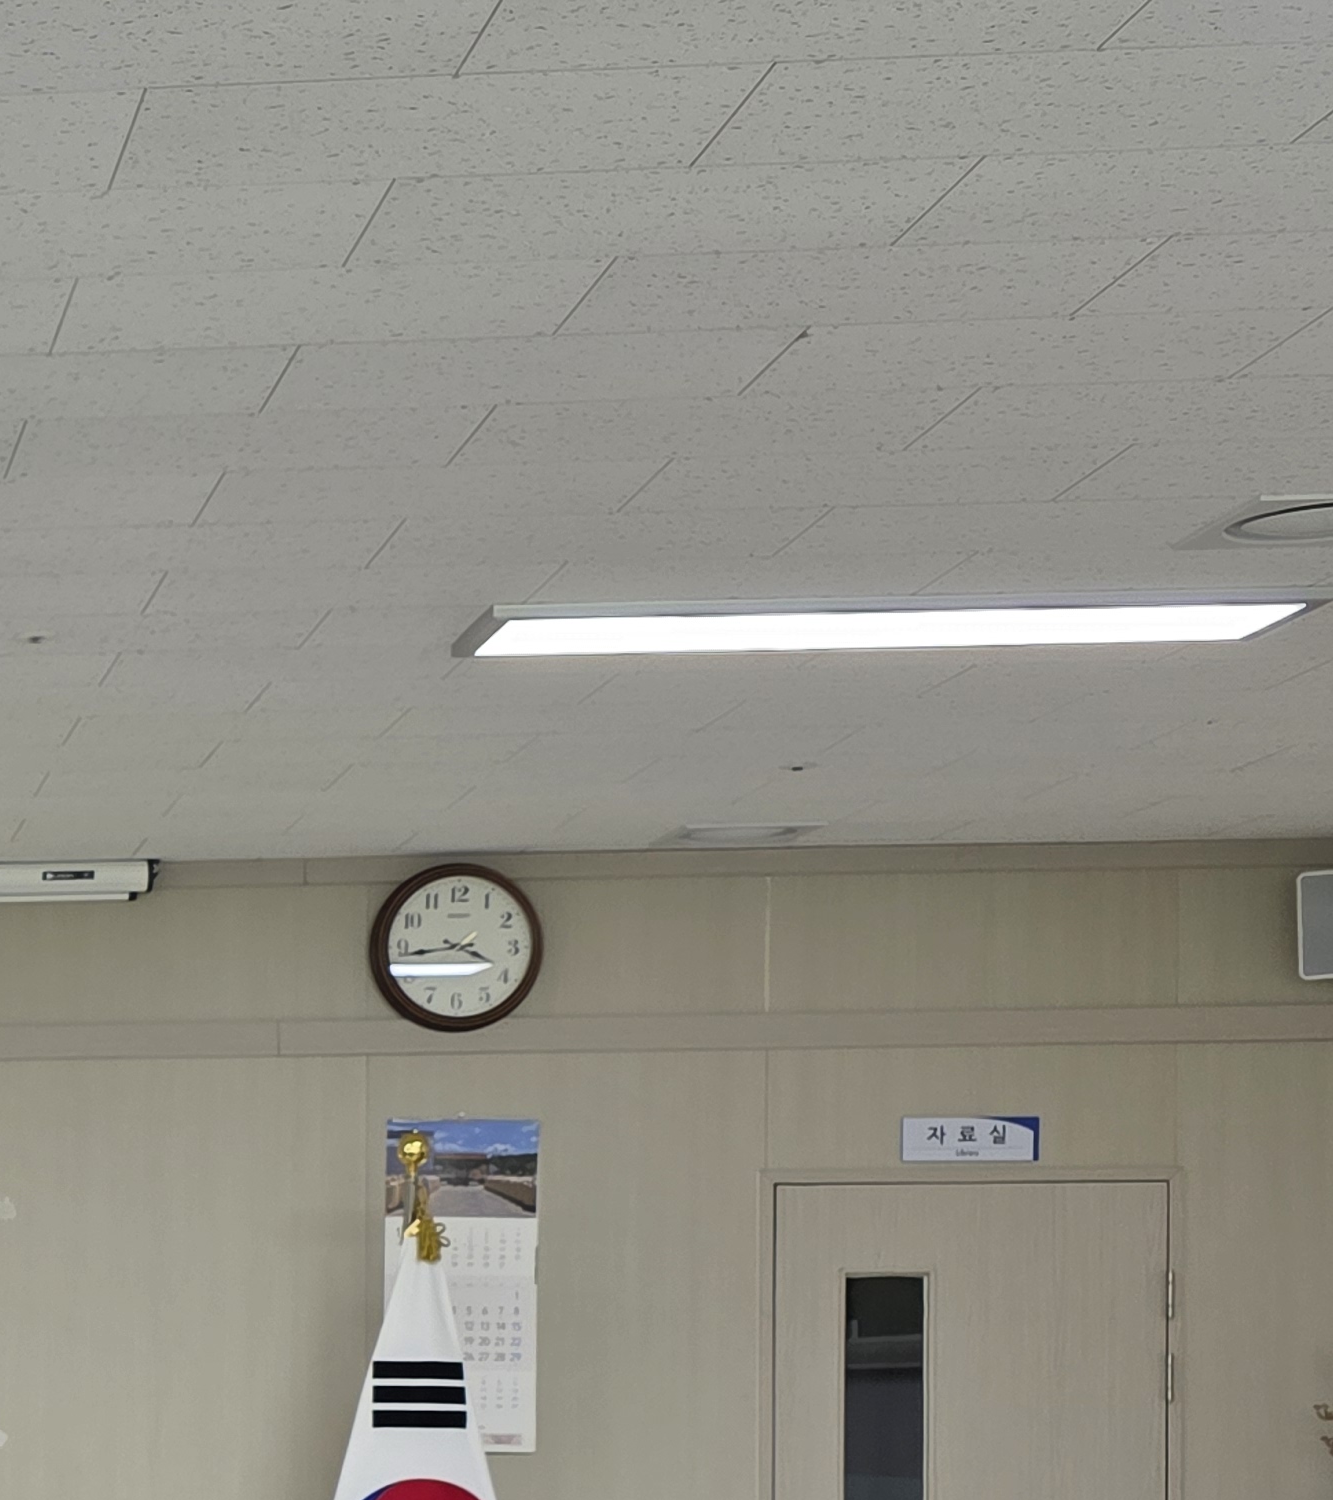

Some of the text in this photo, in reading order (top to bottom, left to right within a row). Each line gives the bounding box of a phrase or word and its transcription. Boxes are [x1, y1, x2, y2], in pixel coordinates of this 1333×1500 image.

[425, 892, 439, 910] 11
[451, 886, 470, 903] 12
[484, 891, 492, 910] 1
[404, 912, 422, 929] 10
[499, 911, 513, 929] 2
[396, 938, 410, 957] 9
[507, 939, 520, 957] 3
[496, 968, 510, 984] 4
[424, 986, 438, 1005] 7
[450, 992, 463, 1011] 6
[478, 986, 491, 1004] 5
